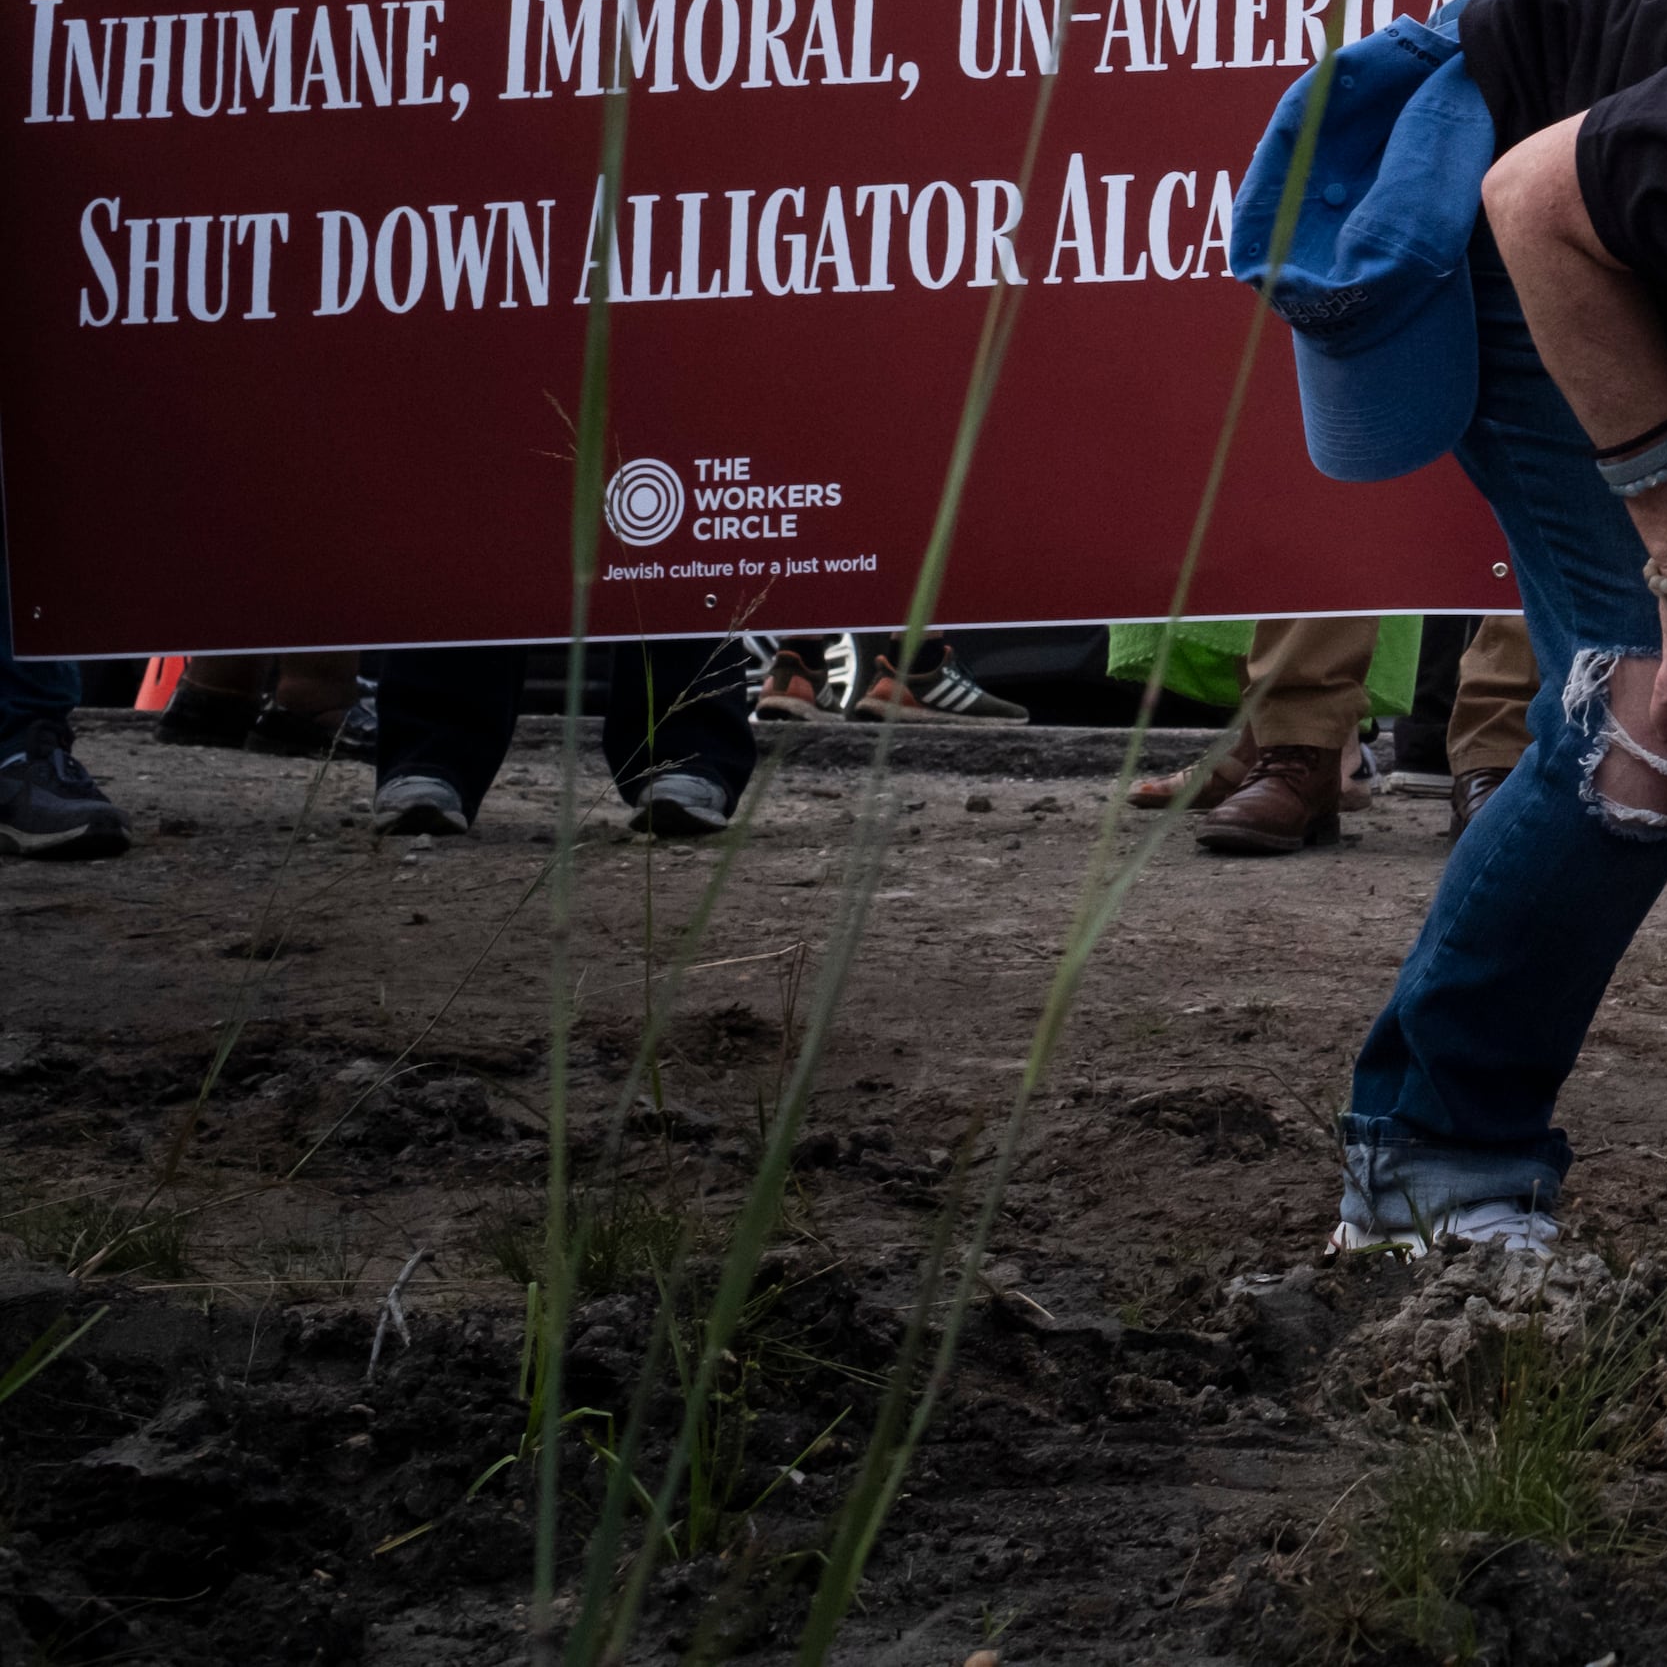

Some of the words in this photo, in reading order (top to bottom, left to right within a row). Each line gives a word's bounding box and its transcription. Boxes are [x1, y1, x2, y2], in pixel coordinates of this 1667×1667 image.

[79, 196, 290, 327] SHUT
[313, 199, 556, 318] DOWN
[574, 174, 1027, 305] ALLIGATOR
[1044, 152, 1234, 285] ALCA
[694, 459, 750, 482] THE
[694, 484, 841, 511] WORKERS
[692, 515, 798, 541] CIRCLE
[602, 560, 664, 582] Jewish
[669, 557, 733, 579] culture
[738, 556, 766, 577] for
[770, 561, 781, 577] a
[785, 555, 819, 579] just
[824, 553, 877, 575] world
